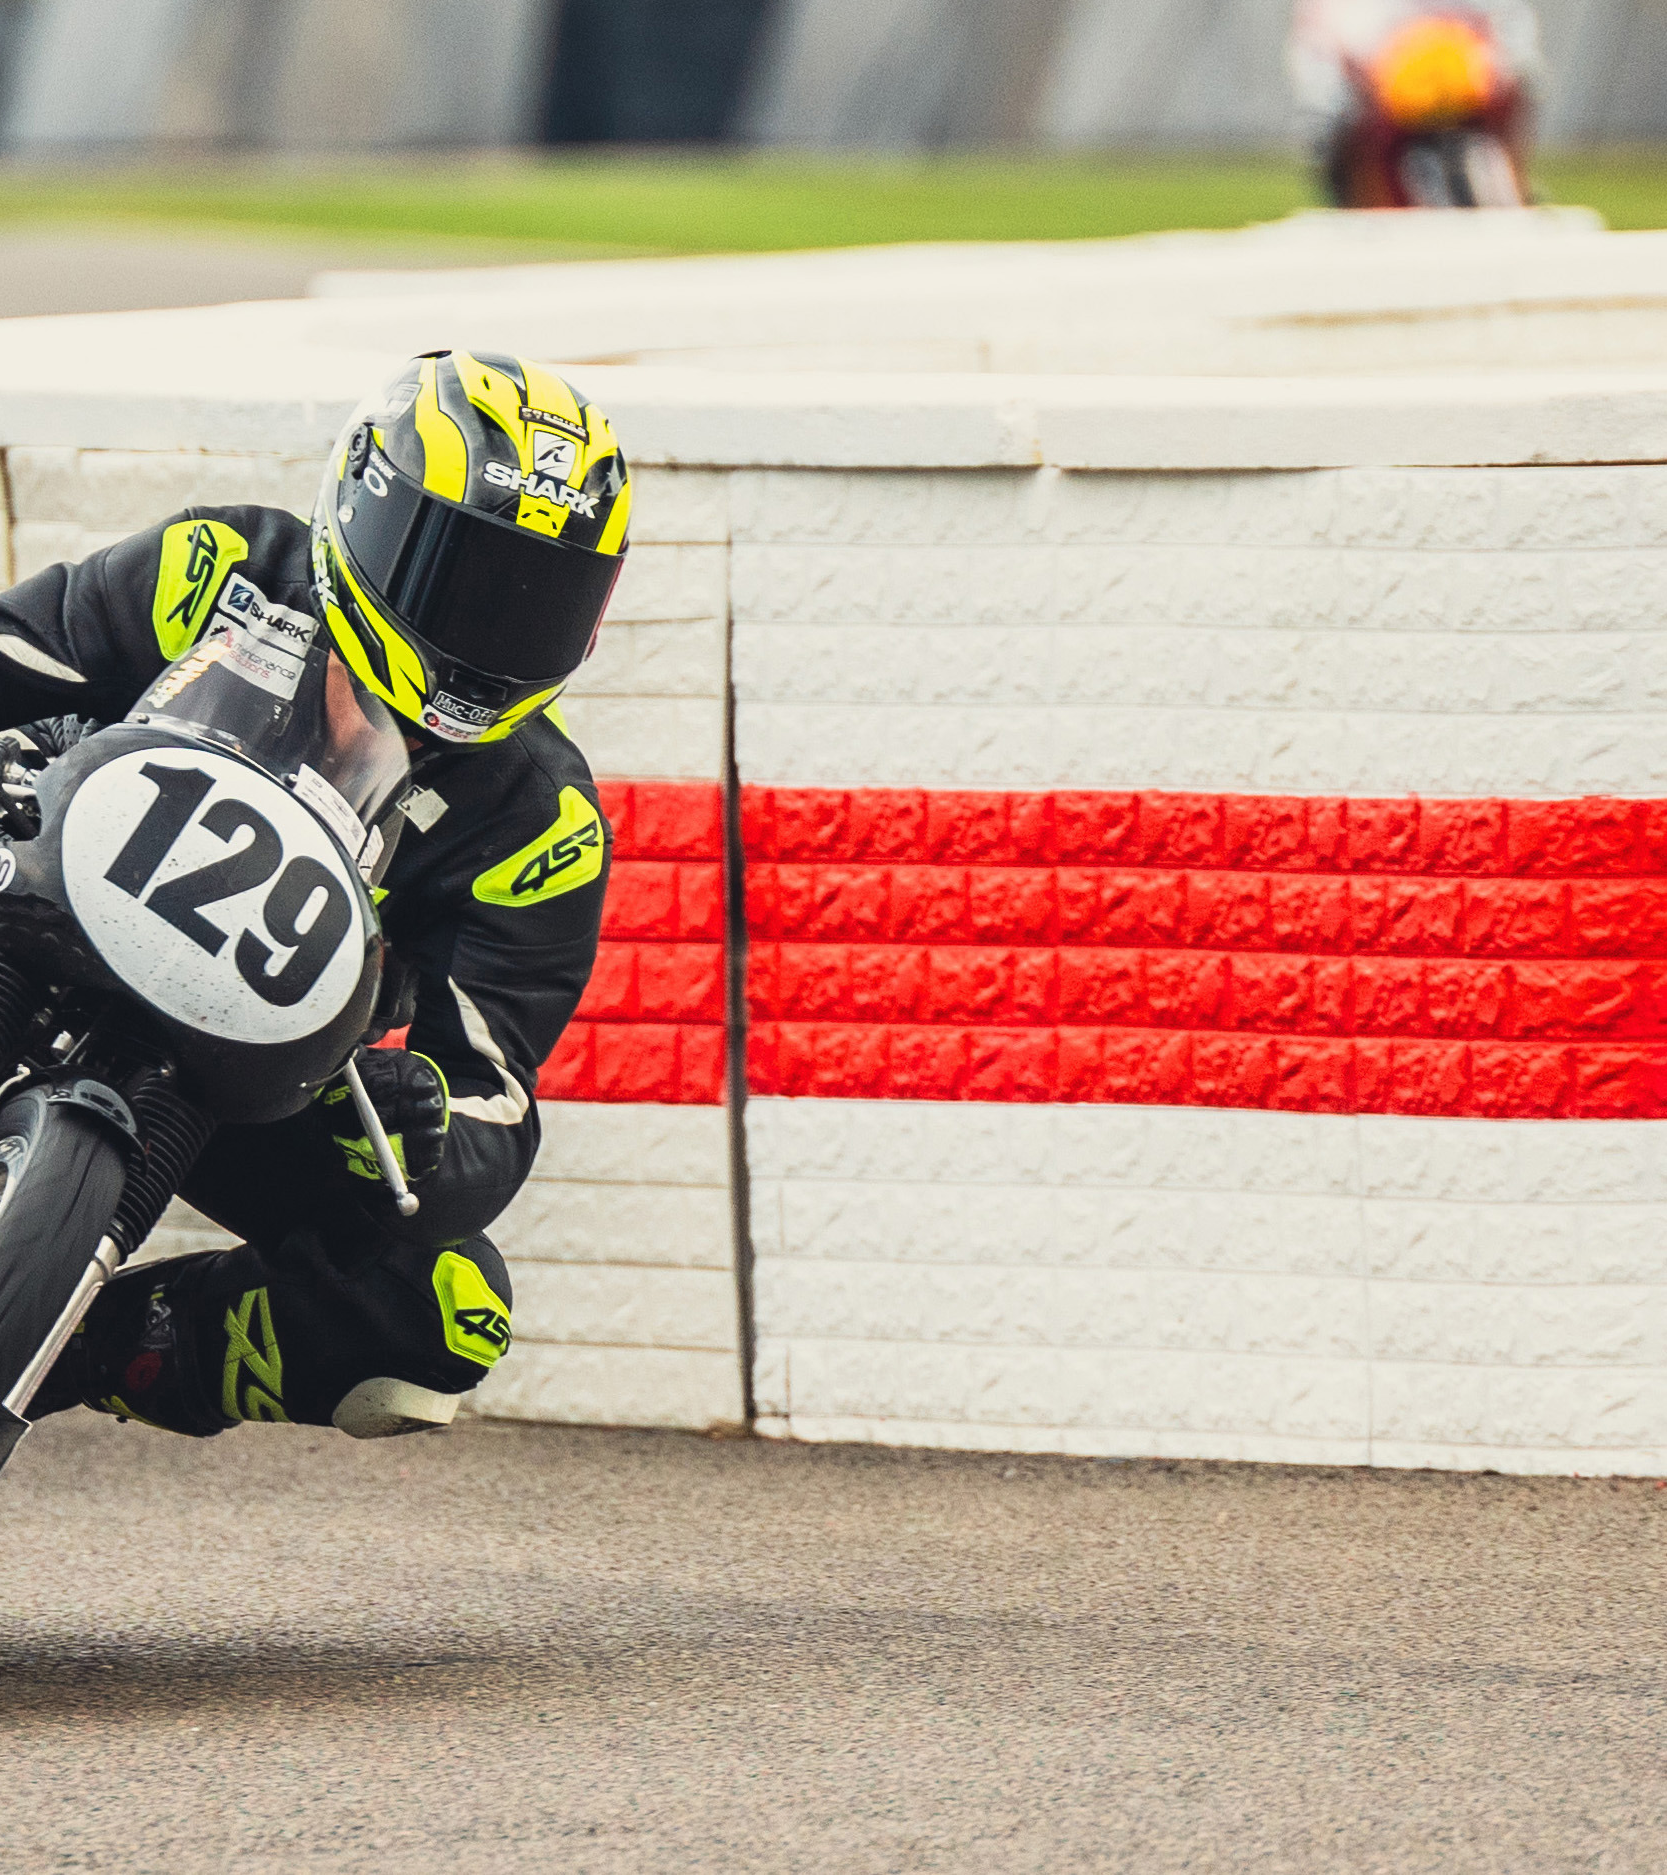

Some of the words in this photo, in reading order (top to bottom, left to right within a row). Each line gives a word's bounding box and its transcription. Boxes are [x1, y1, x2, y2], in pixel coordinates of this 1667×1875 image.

[483, 460, 600, 520] SHARK
[166, 523, 218, 629] 4SR
[249, 601, 312, 643] SHARK
[103, 760, 353, 1008] 129
[510, 819, 600, 896] 4SR
